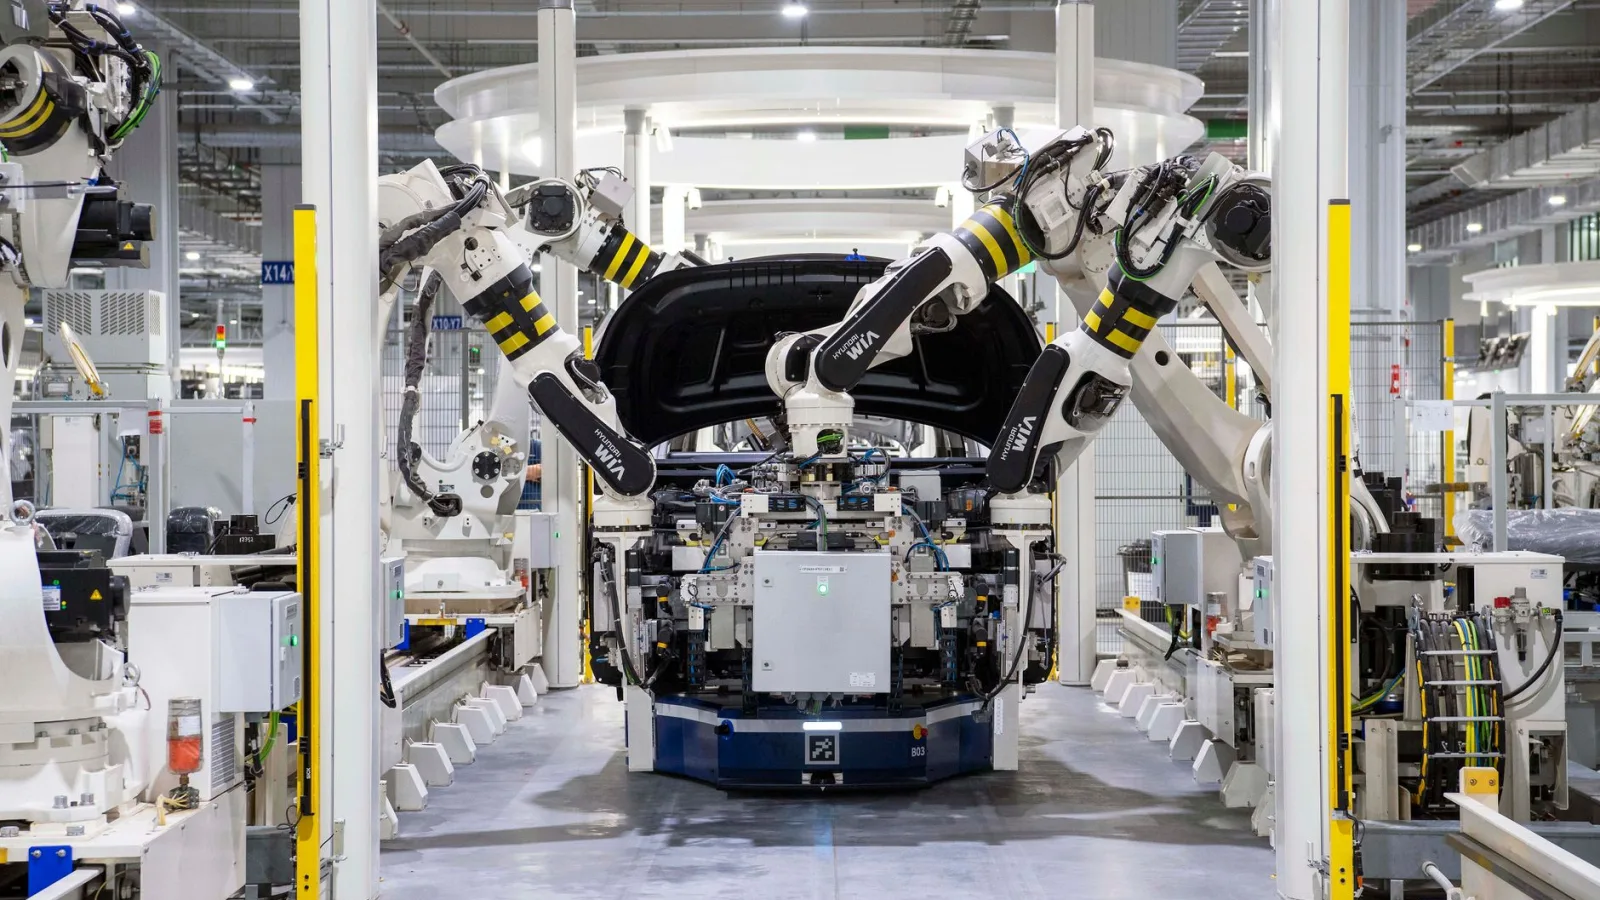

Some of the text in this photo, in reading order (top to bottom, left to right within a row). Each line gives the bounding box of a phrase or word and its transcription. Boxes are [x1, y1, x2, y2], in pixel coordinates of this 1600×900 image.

[832, 333, 860, 360] HYUNDAI
[594, 428, 622, 458] HYUNDAI
[1000, 426, 1018, 461] HYUNDAI
[911, 746, 925, 757] B03
